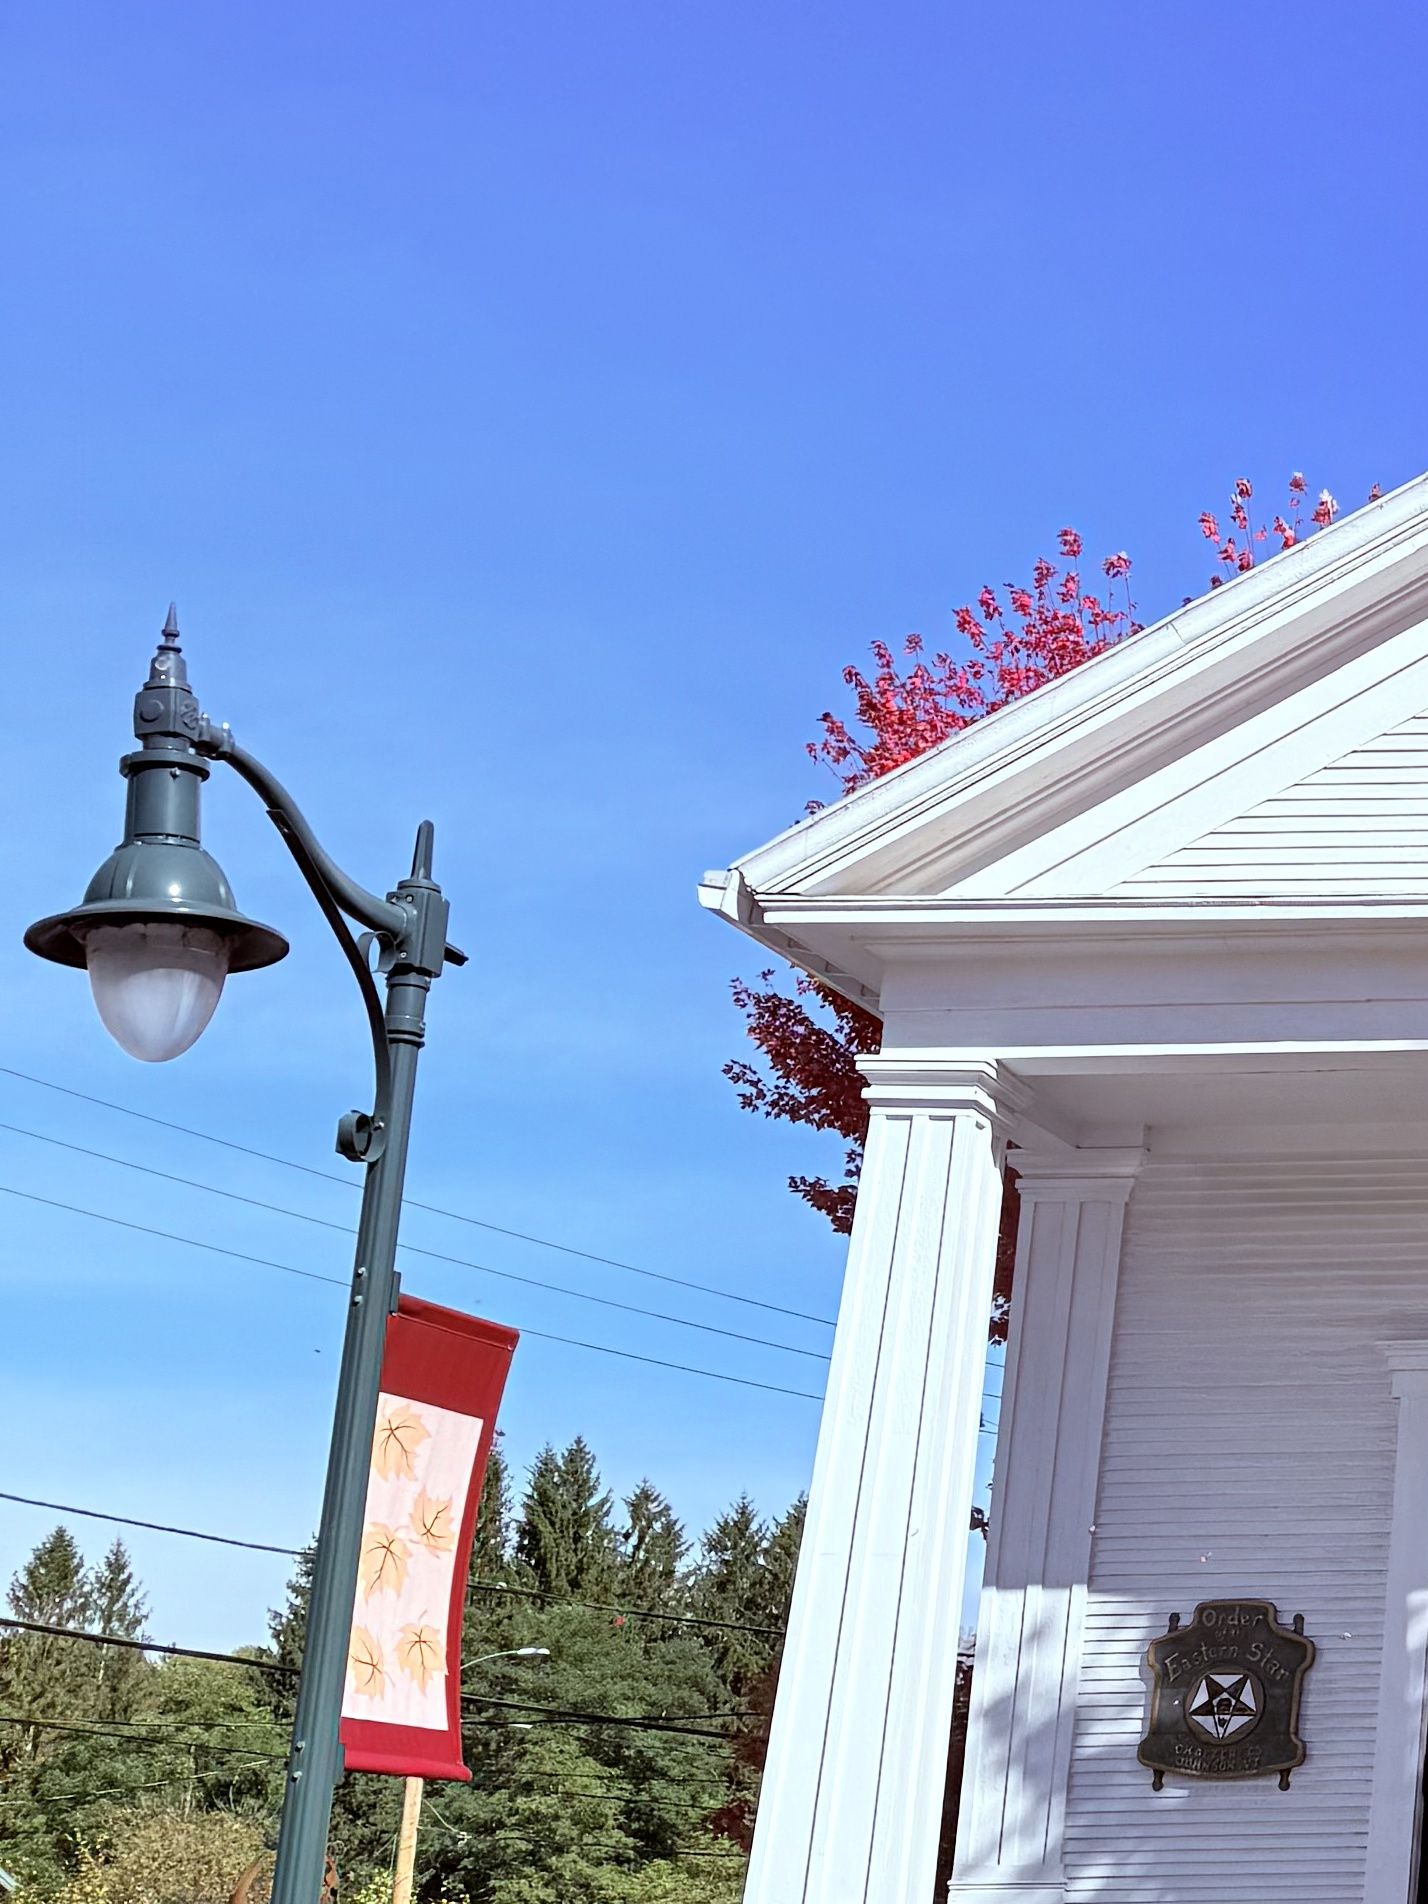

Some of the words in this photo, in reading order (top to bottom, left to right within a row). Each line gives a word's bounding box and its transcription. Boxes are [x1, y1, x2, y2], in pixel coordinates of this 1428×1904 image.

[1202, 1608, 1264, 1628] Order
[1164, 1643, 1239, 1683] Eastern
[1246, 1643, 1291, 1681] Star
